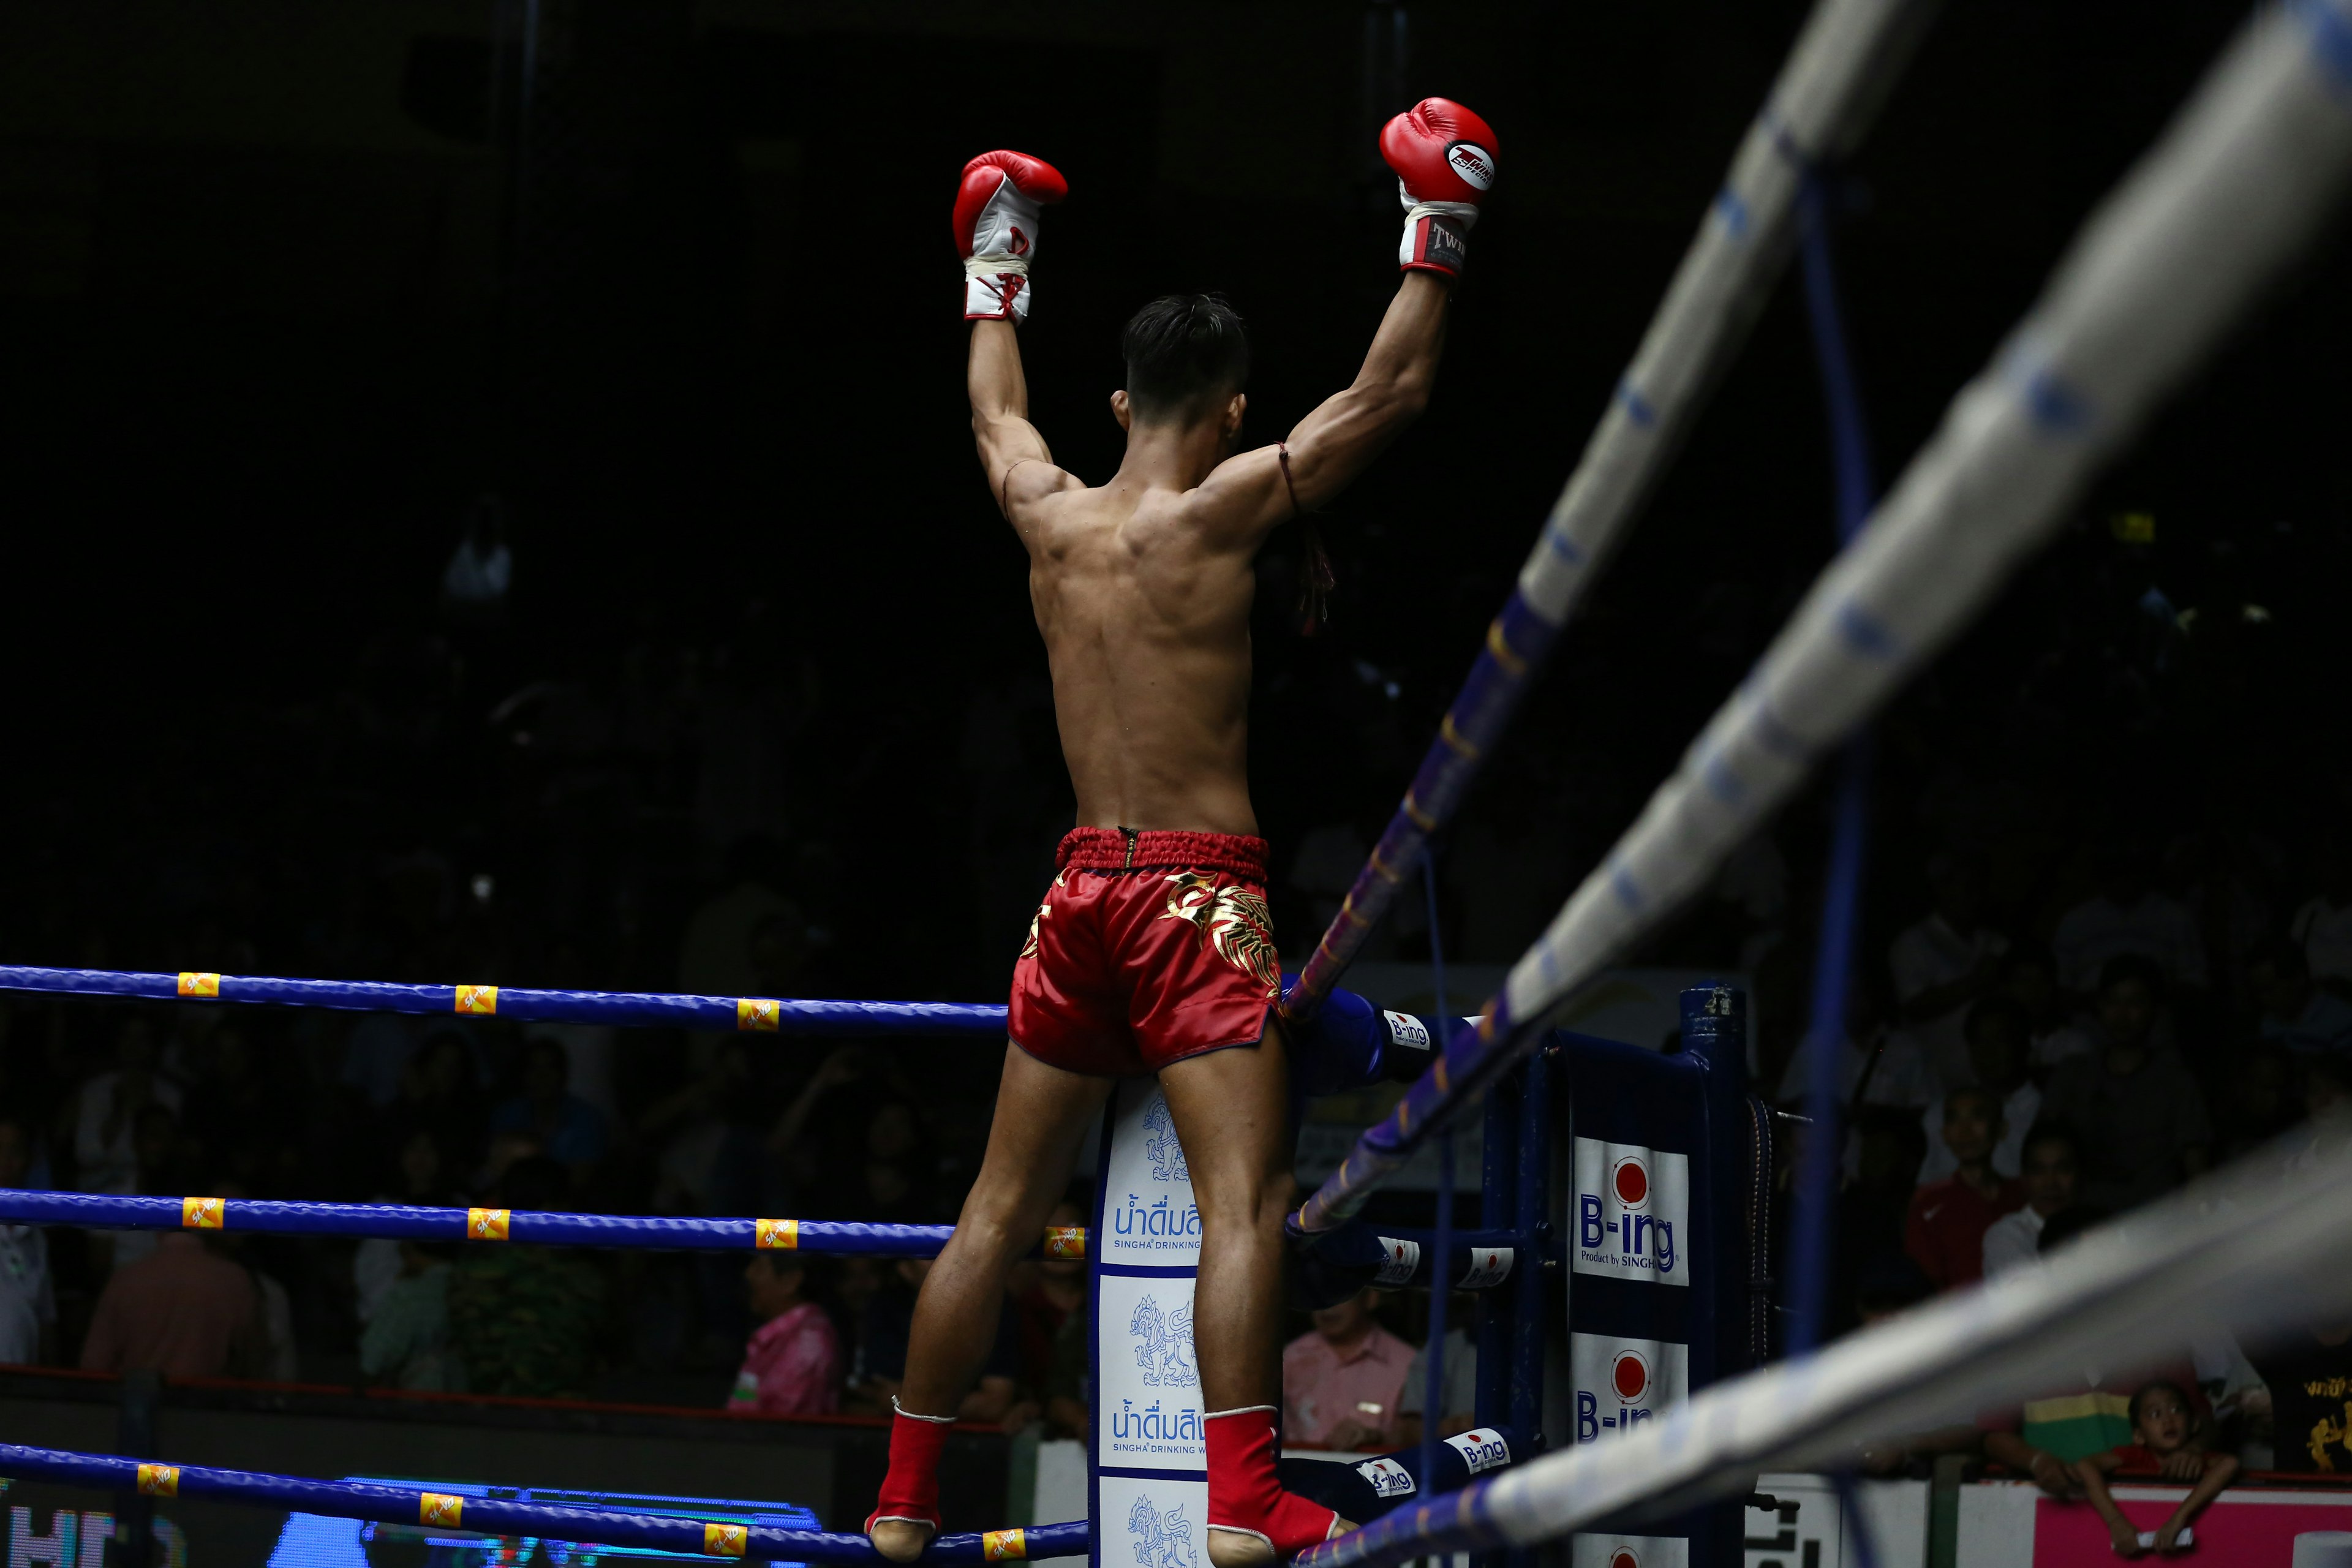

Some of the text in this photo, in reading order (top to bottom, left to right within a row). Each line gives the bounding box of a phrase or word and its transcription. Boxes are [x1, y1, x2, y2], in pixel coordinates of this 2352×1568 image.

[1390, 1019, 1426, 1046] B-ing
[1581, 1194, 1674, 1272] B-ing
[1581, 1251, 1657, 1269] Product by SINGH
[1578, 1390, 1667, 1444] B-in
[1463, 1441, 1505, 1464] B-ing
